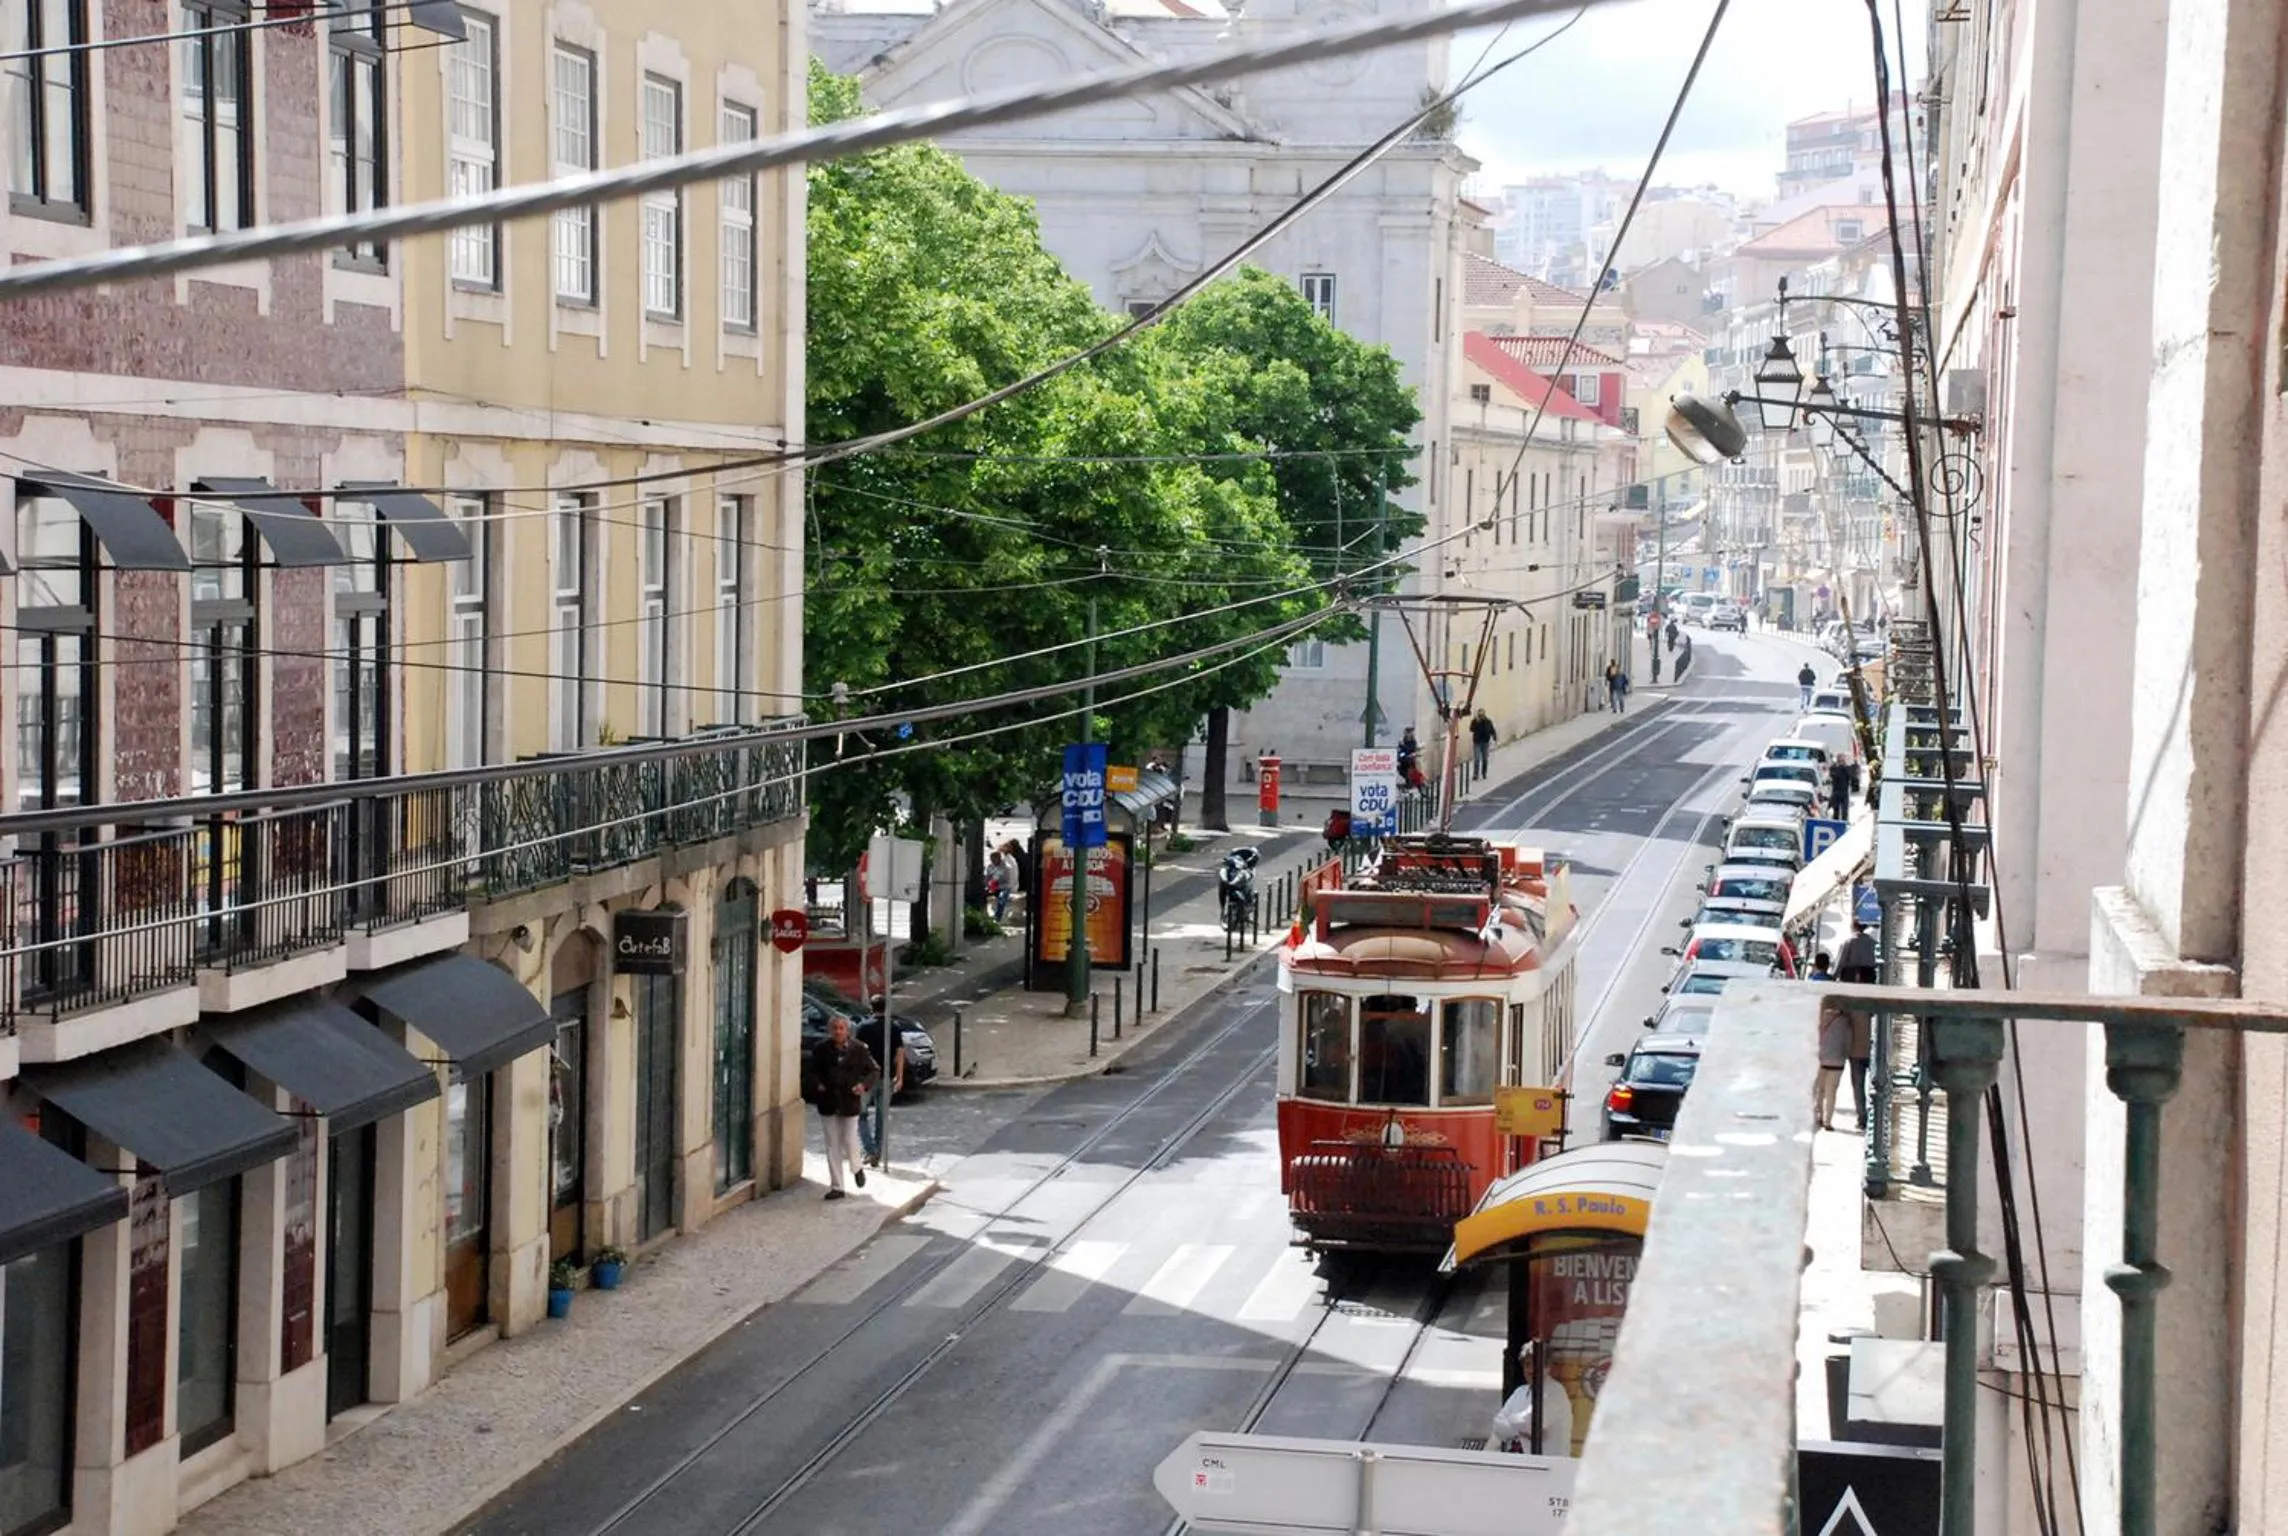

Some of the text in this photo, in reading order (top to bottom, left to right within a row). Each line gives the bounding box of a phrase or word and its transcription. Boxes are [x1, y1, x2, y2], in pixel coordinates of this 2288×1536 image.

[1064, 769, 1102, 788] vota
[1062, 789, 1104, 807] CDU
[1360, 783, 1388, 797] vota
[1359, 799, 1388, 812] CDU
[1812, 826, 1837, 859] P
[1535, 1196, 1626, 1216] R. S. Paulo
[1574, 1280, 1589, 1305] A
[1202, 1458, 1226, 1469] CML
